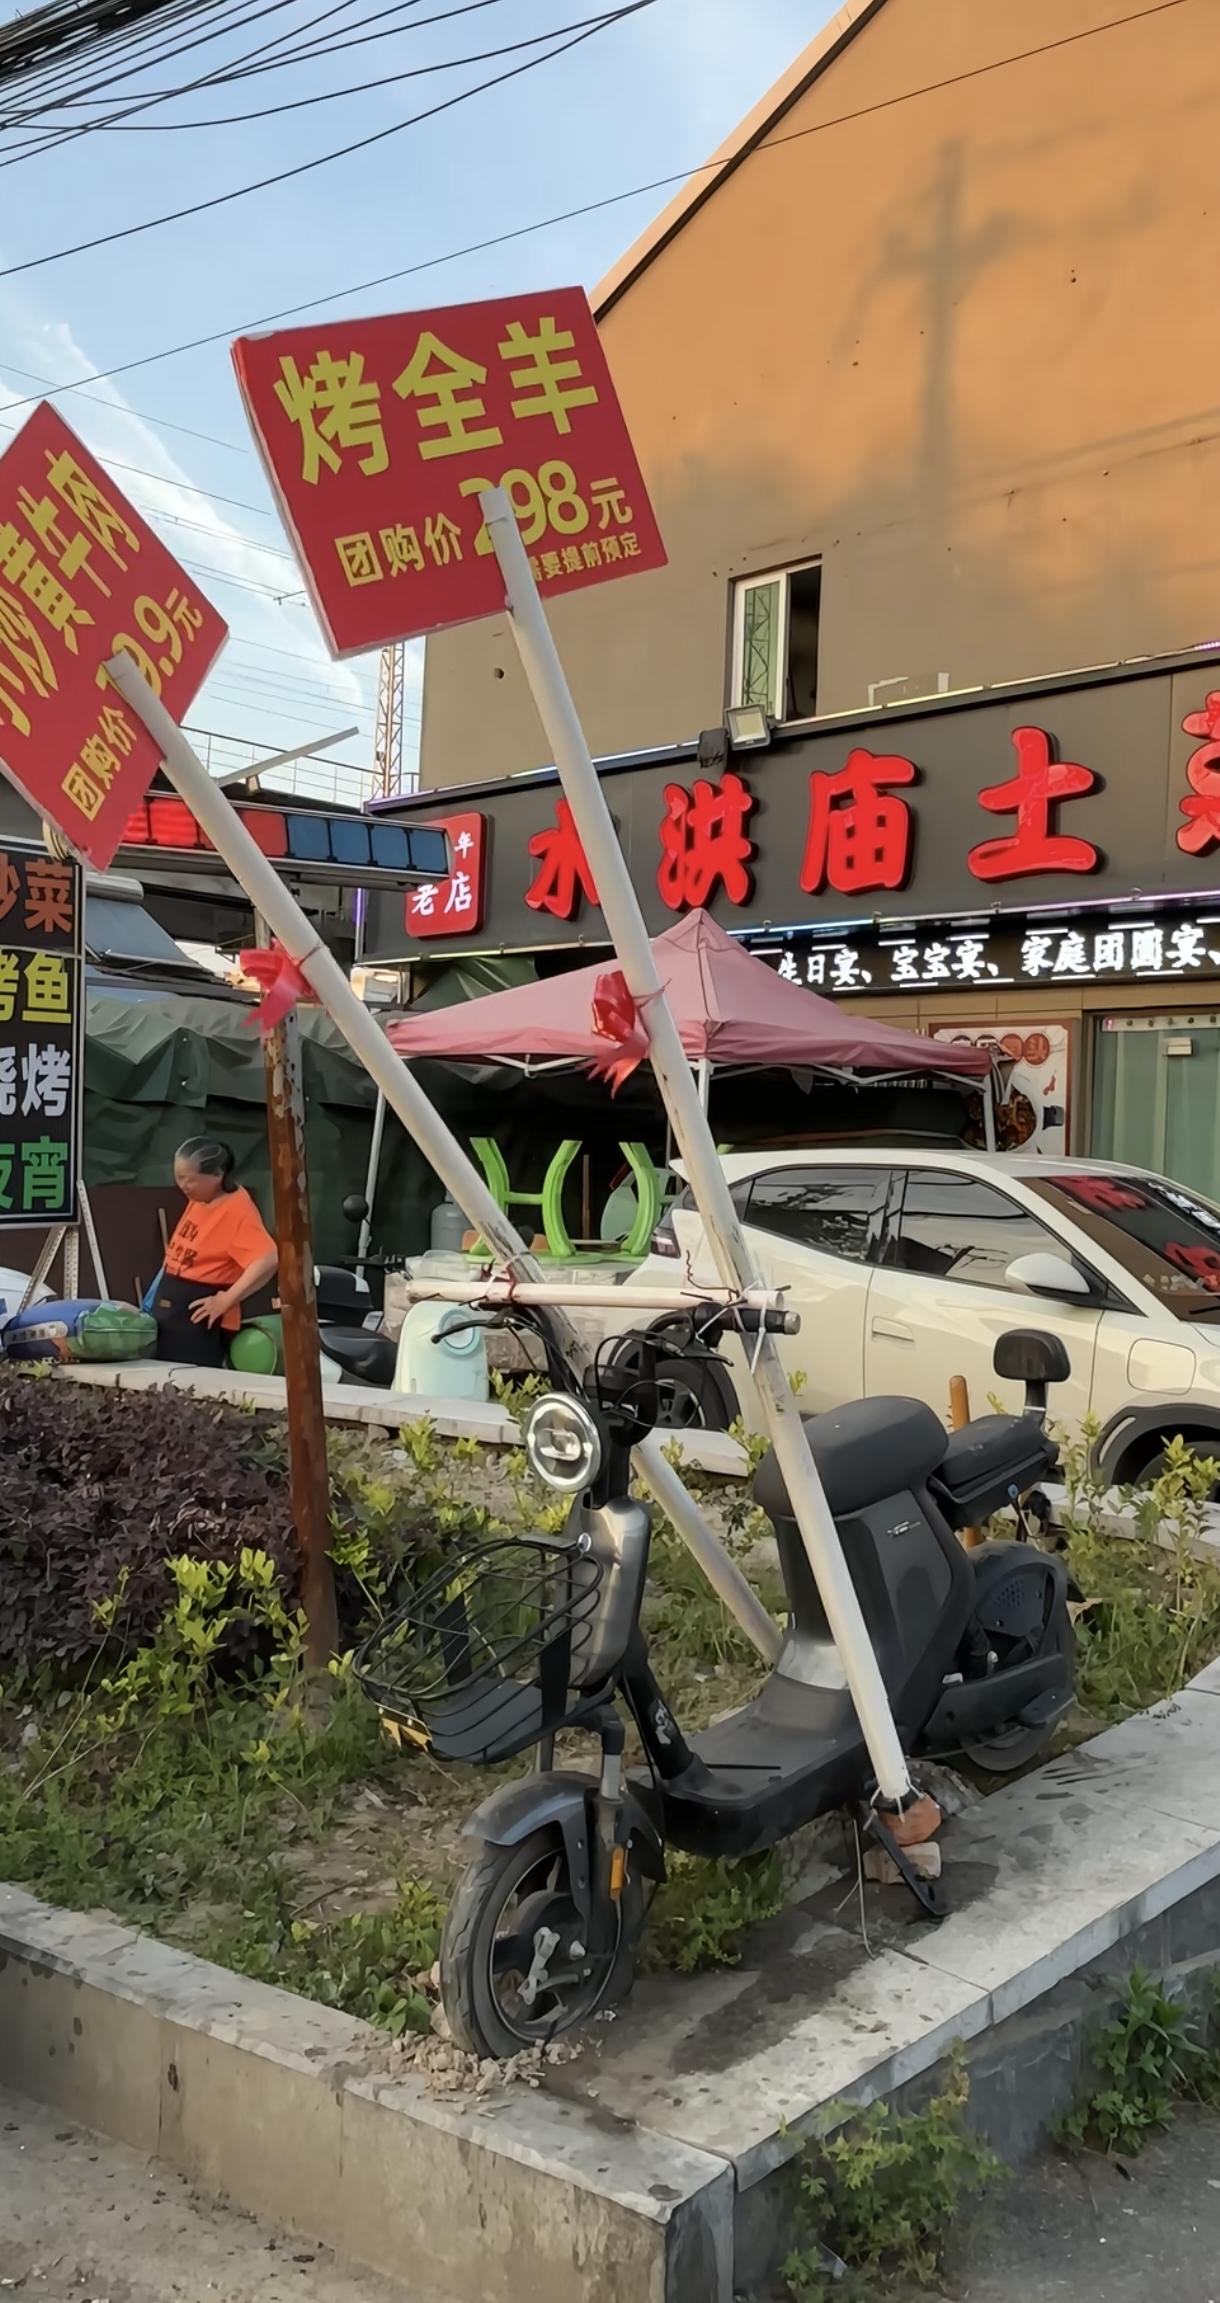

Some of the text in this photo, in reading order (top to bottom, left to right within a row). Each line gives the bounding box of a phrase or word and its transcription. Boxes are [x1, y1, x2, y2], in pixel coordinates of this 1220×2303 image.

[274, 317, 598, 485] 烤全羊
[411, 871, 473, 916] 老店
